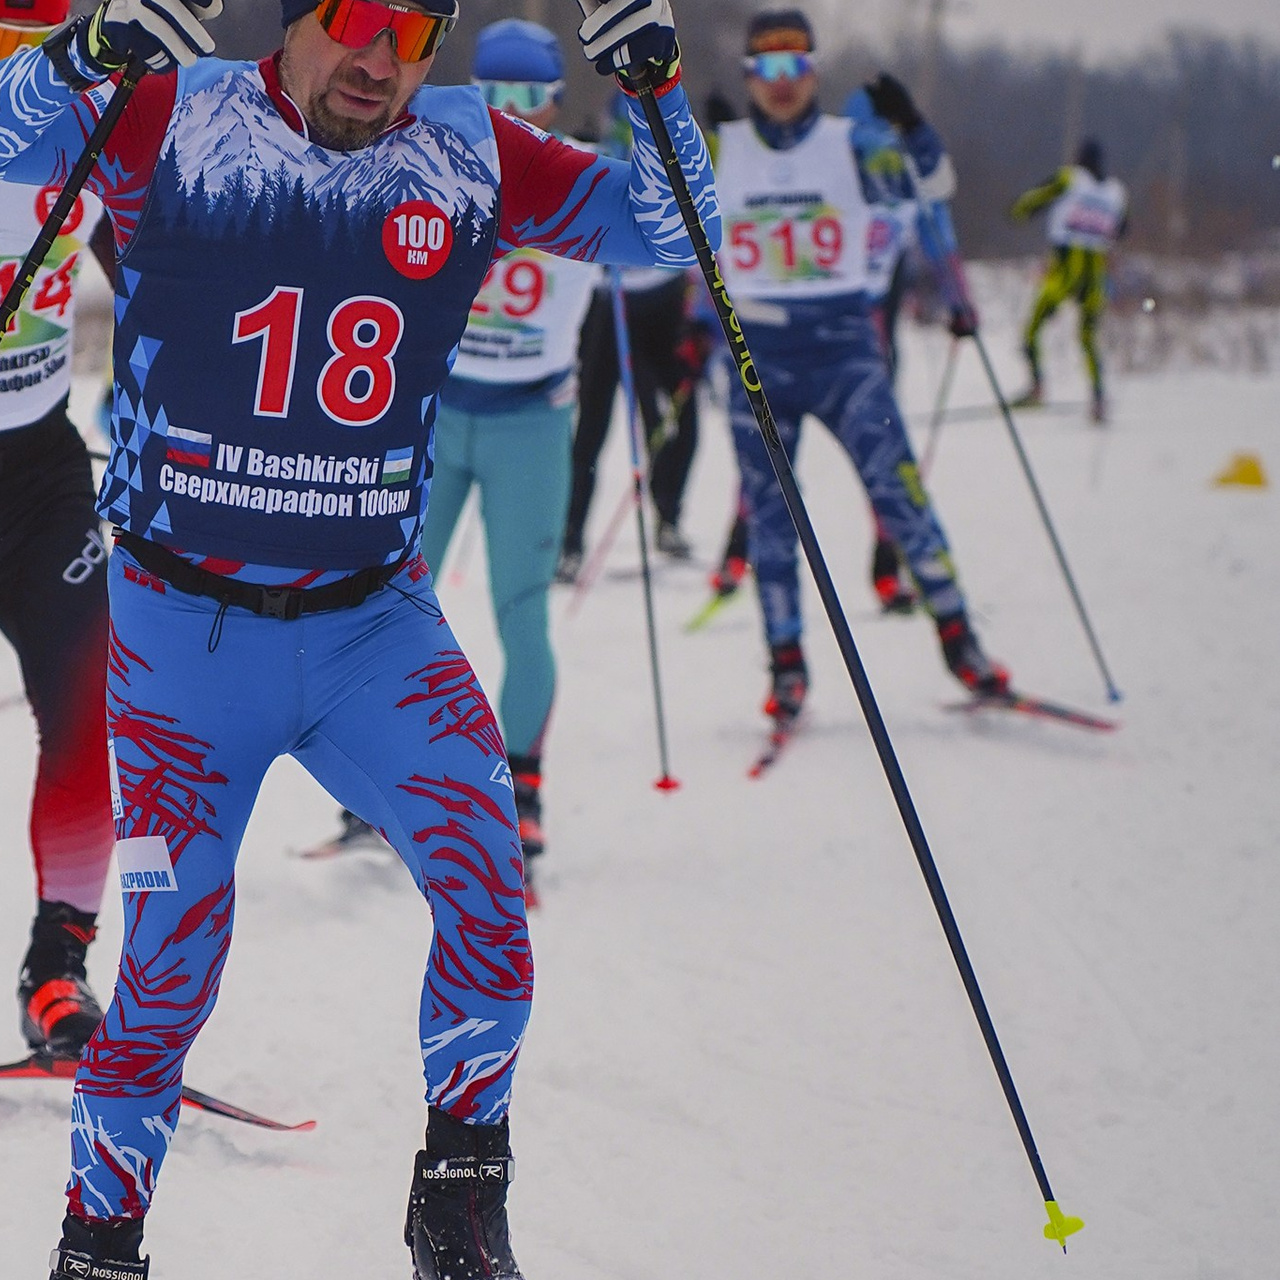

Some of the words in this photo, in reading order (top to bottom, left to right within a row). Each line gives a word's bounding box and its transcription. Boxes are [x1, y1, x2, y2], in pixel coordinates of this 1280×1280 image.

[393, 214, 445, 250] 100
[730, 217, 843, 270] 519
[407, 249, 428, 266] КМ
[232, 285, 405, 427] 18
[216, 443, 244, 473] IV
[247, 448, 380, 485] BashkirSki
[159, 464, 355, 518] Сверхмарафон
[422, 1167, 478, 1180] ROSSIGNOL
